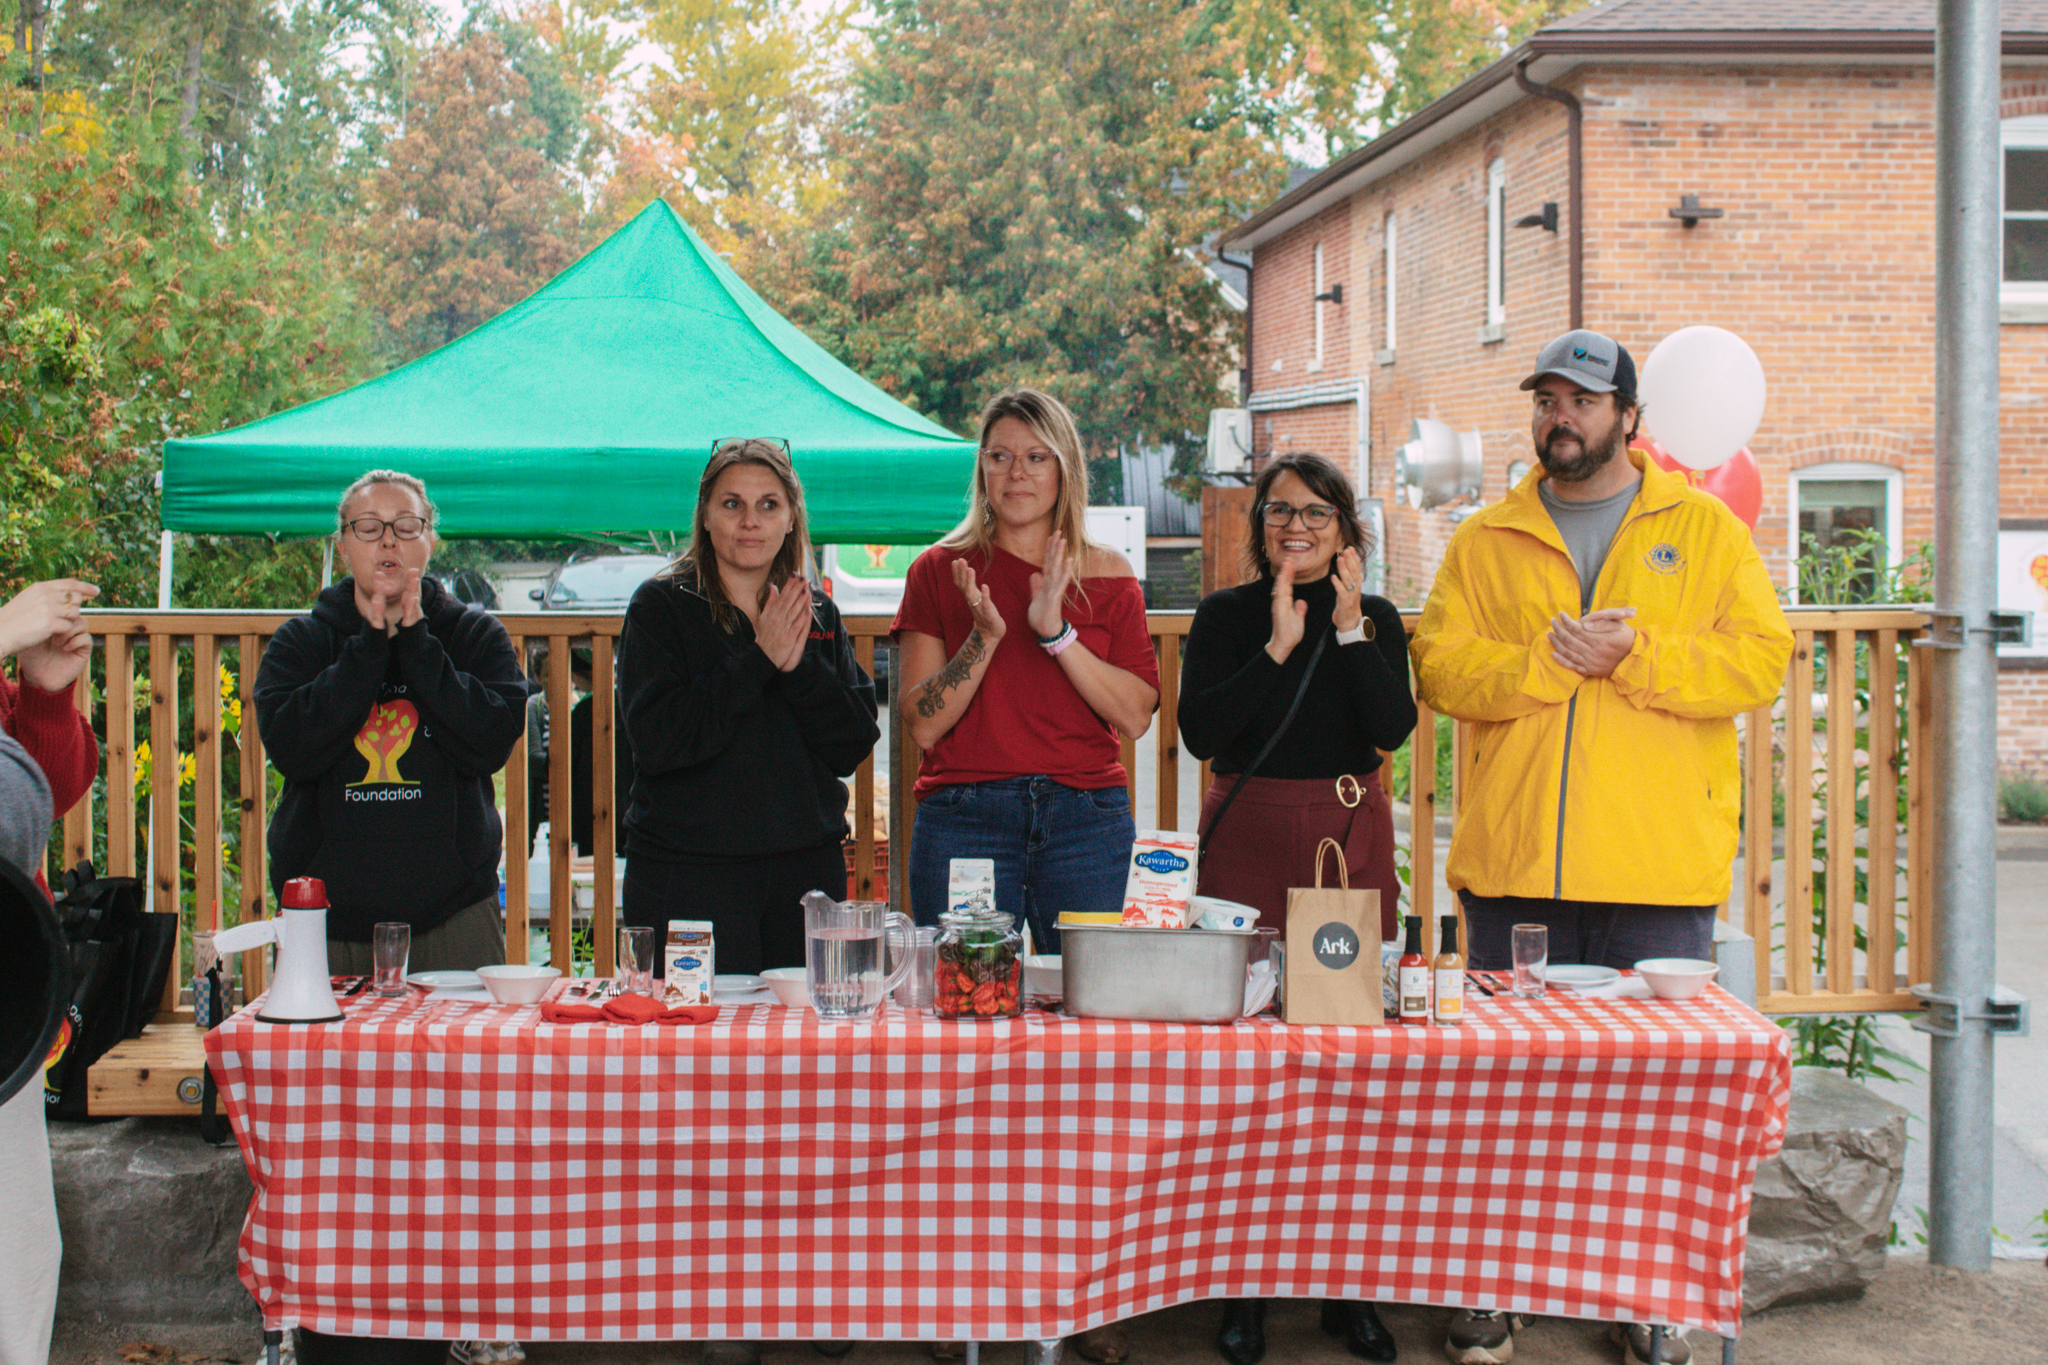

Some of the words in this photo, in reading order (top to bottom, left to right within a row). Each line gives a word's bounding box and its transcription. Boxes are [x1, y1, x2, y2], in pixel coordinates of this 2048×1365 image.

[1661, 550, 1669, 561] L
[345, 787, 422, 802] Foundation
[1139, 855, 1186, 868] Kawartha
[1319, 937, 1353, 955] Ark.
